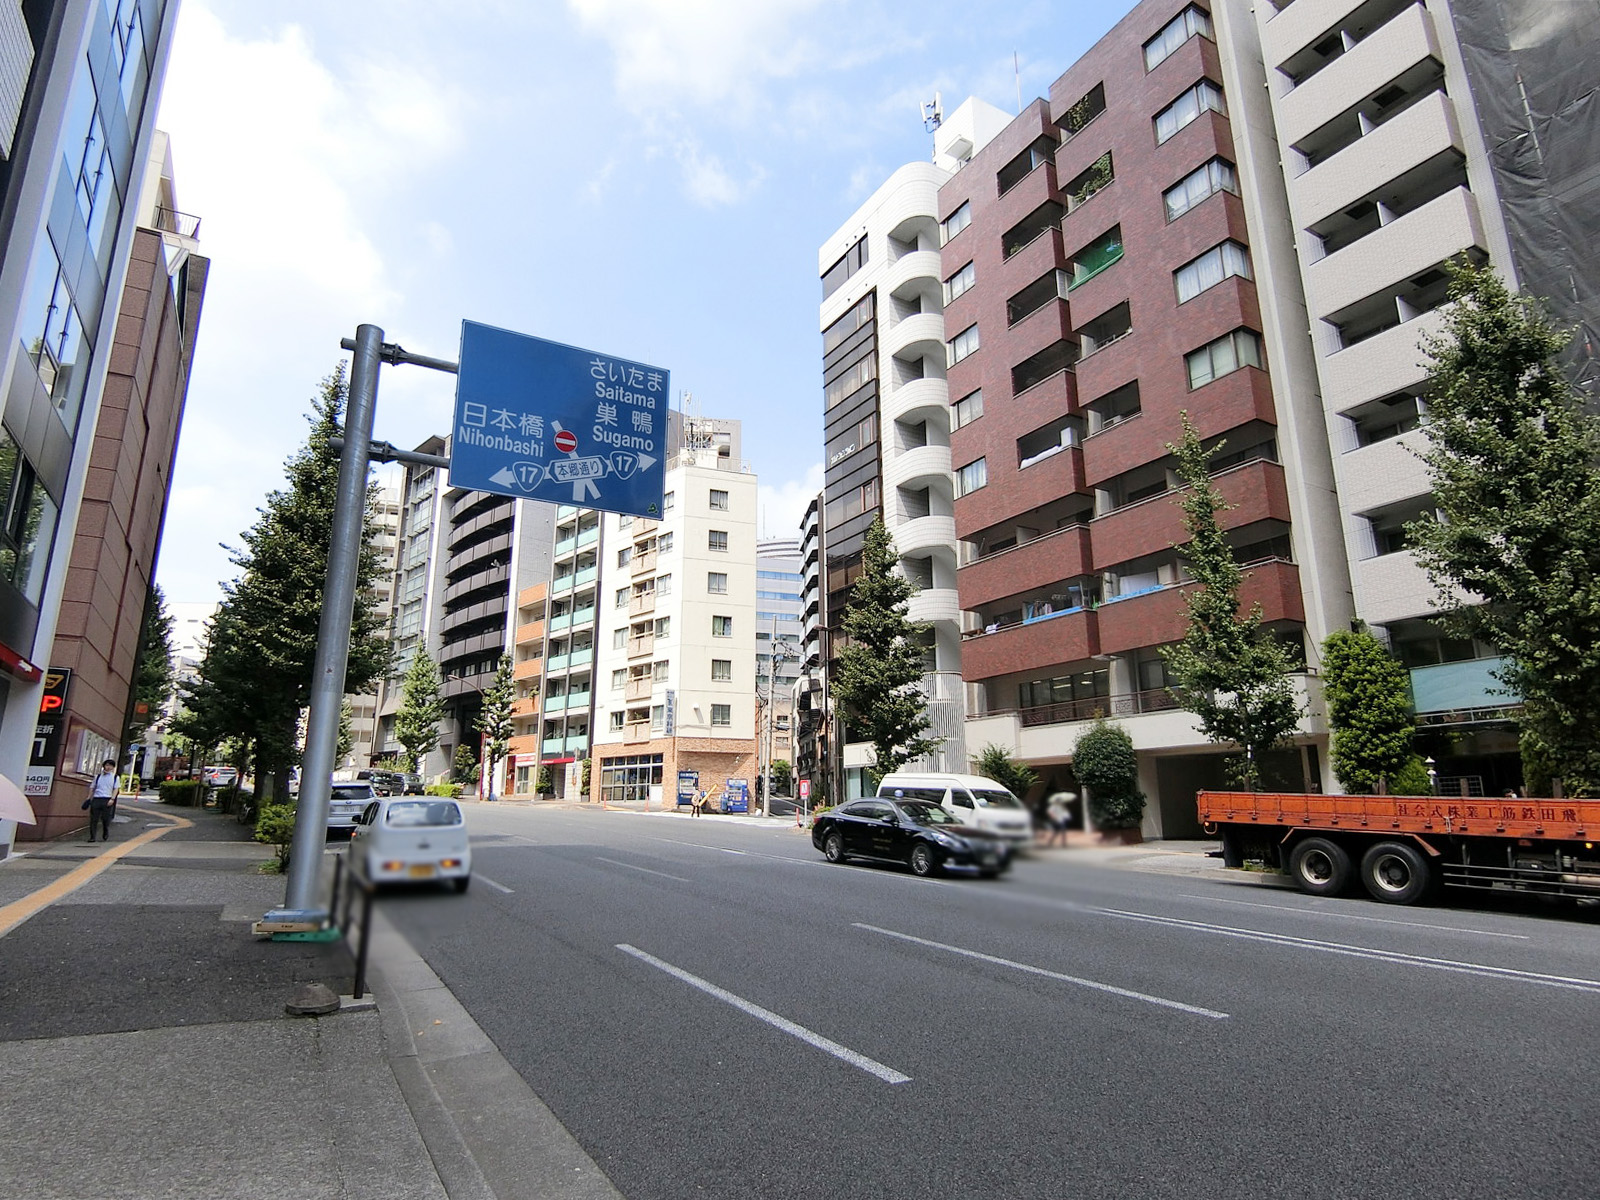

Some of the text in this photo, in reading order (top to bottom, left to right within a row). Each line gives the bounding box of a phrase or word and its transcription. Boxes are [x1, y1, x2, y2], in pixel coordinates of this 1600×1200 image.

[589, 357, 663, 392] さいたま
[595, 381, 656, 409] Saitama
[462, 401, 544, 439] 日本橋
[595, 402, 653, 435] 巣鴨
[458, 426, 544, 458] Nihonbashi
[592, 424, 654, 452] Sugamo
[519, 466, 538, 483] 17
[557, 457, 601, 478] 本郷通り
[615, 455, 633, 471] 17
[41, 695, 62, 712] P
